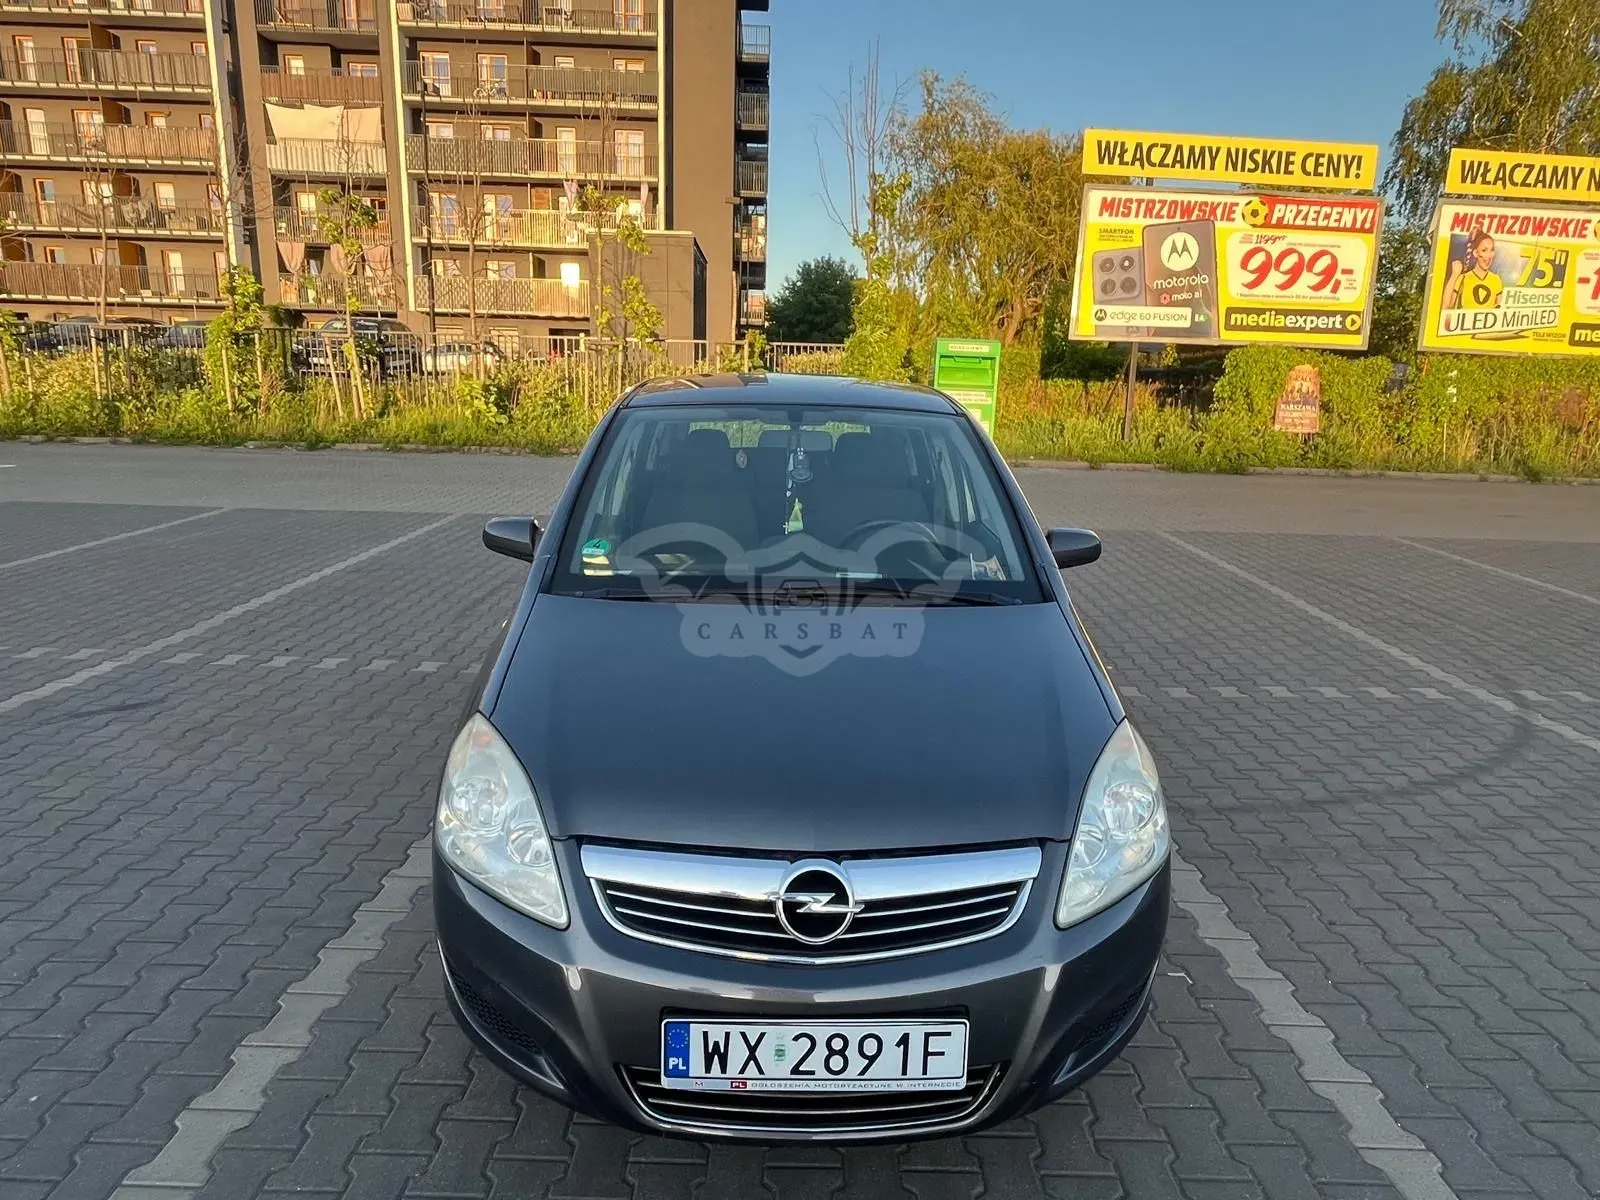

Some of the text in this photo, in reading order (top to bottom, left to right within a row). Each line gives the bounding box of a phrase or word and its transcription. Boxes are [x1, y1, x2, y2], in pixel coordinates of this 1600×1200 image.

[1097, 139, 1363, 179] WŁĄCZAMY NISKIE CENY!
[1460, 160, 1584, 190] WŁĄCZAMY
[1098, 196, 1375, 229] MISTRZOWSKIE PRZECENY!
[1450, 212, 1592, 239] MISTRZOWSKIE
[1153, 273, 1209, 289] motorola
[1171, 292, 1193, 301] moto
[1505, 290, 1559, 304] Hisense
[1109, 311, 1138, 323] edge
[1139, 313, 1151, 321] 60
[1153, 313, 1188, 321] FUSION
[1230, 310, 1343, 331] mediaexpert
[1444, 310, 1557, 332] ULED MiniLED
[702, 1030, 767, 1075] WX
[790, 1032, 952, 1076] 2891F
[668, 1057, 687, 1071] PL
